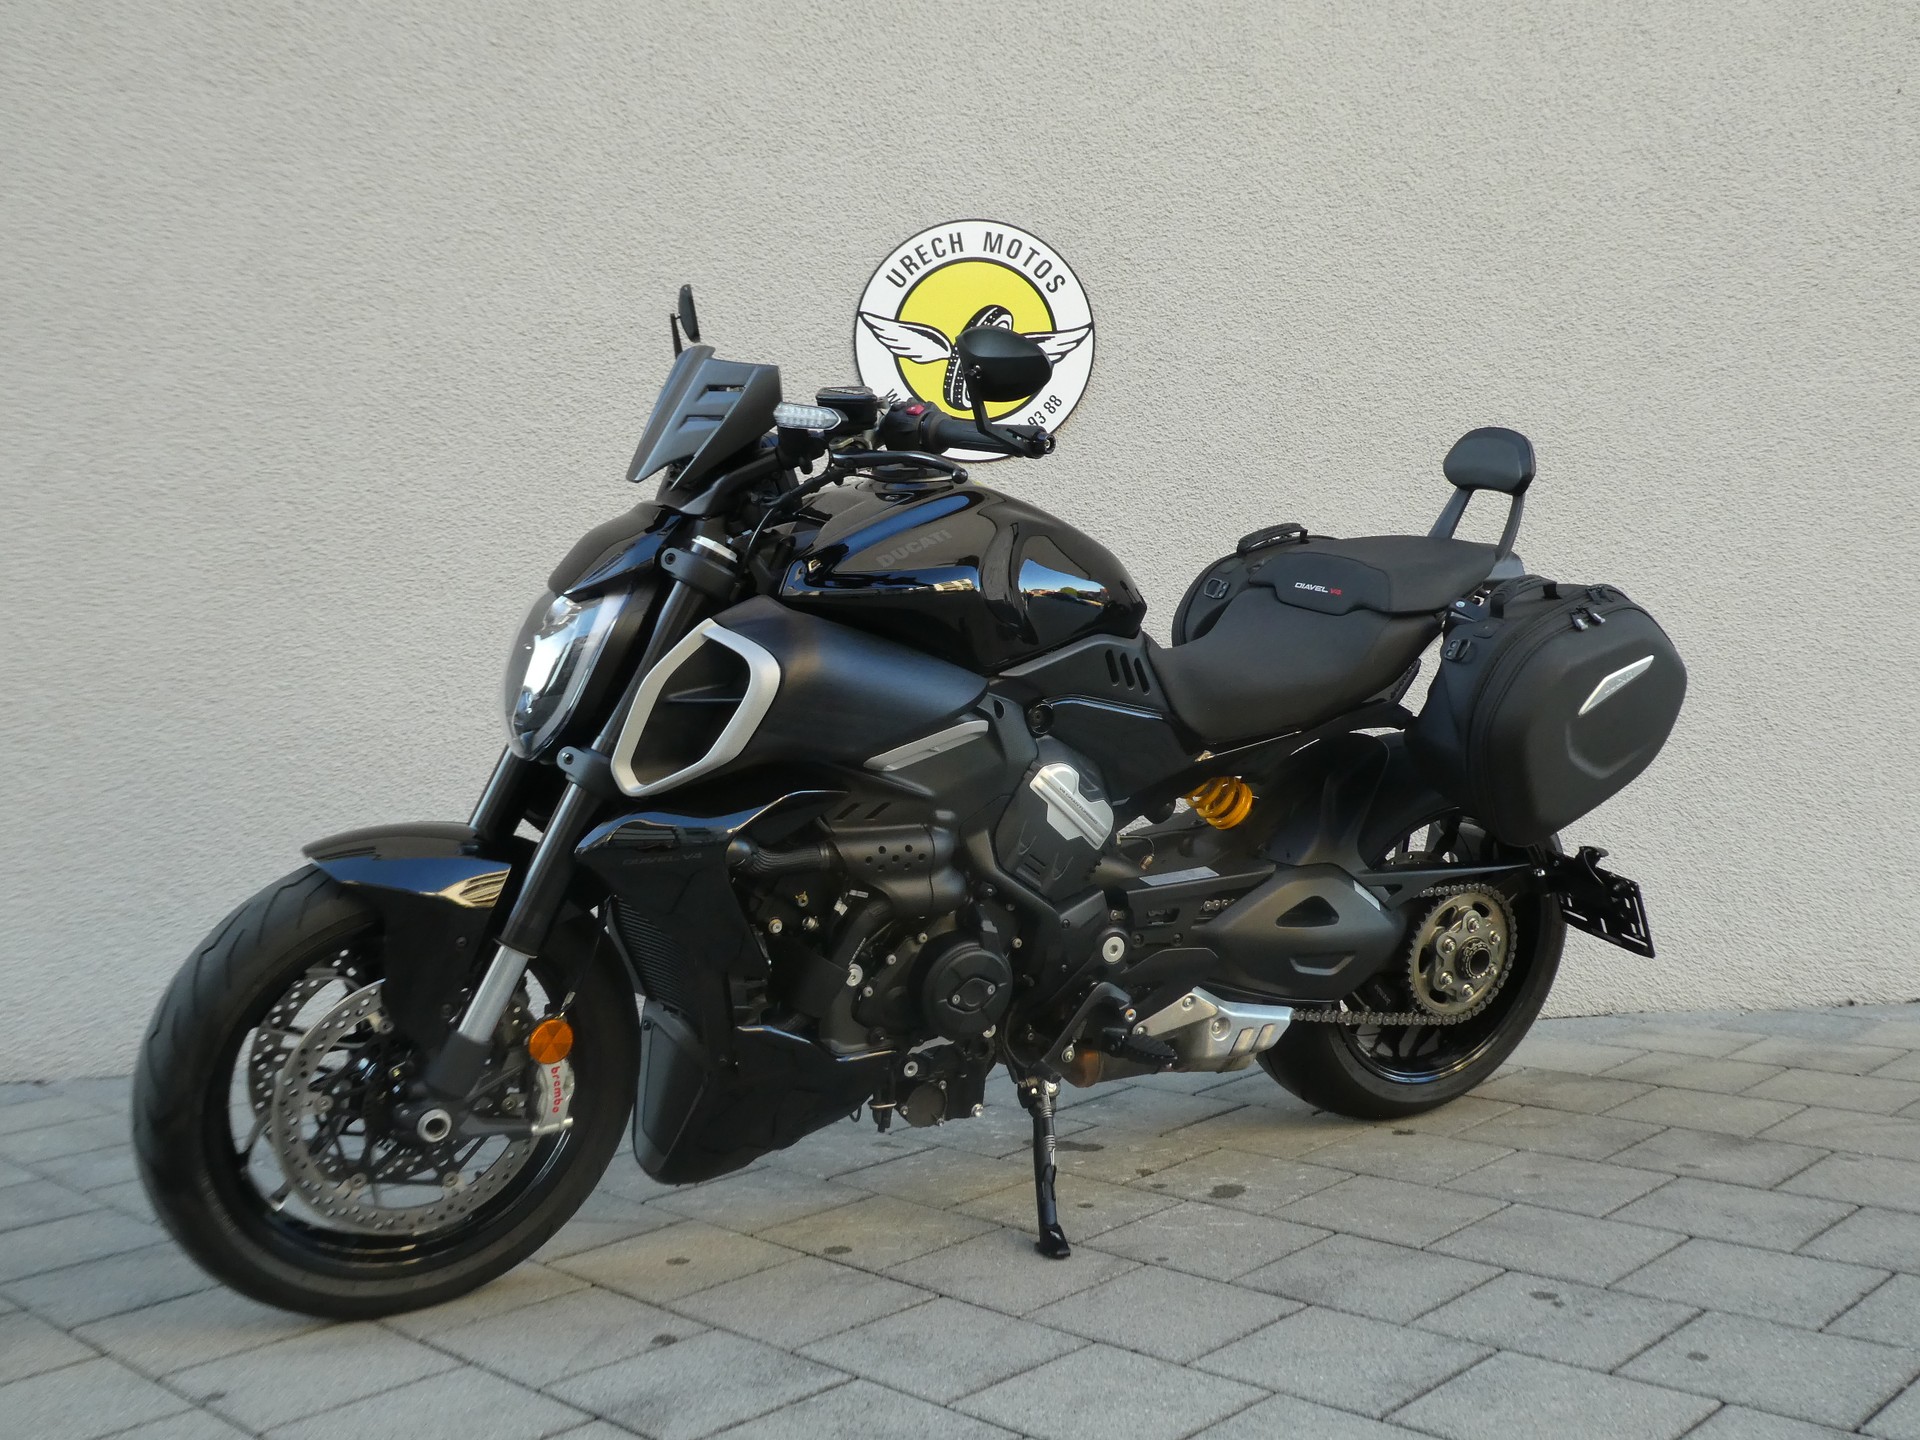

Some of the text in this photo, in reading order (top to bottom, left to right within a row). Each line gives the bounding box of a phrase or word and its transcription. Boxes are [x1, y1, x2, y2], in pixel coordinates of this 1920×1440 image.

[886, 231, 1066, 293] URECH MOTOS
[1027, 395, 1062, 426] 93 88
[876, 529, 953, 568] DUCATI
[1294, 581, 1329, 593] DIAVEL
[550, 1066, 564, 1113] brembo
